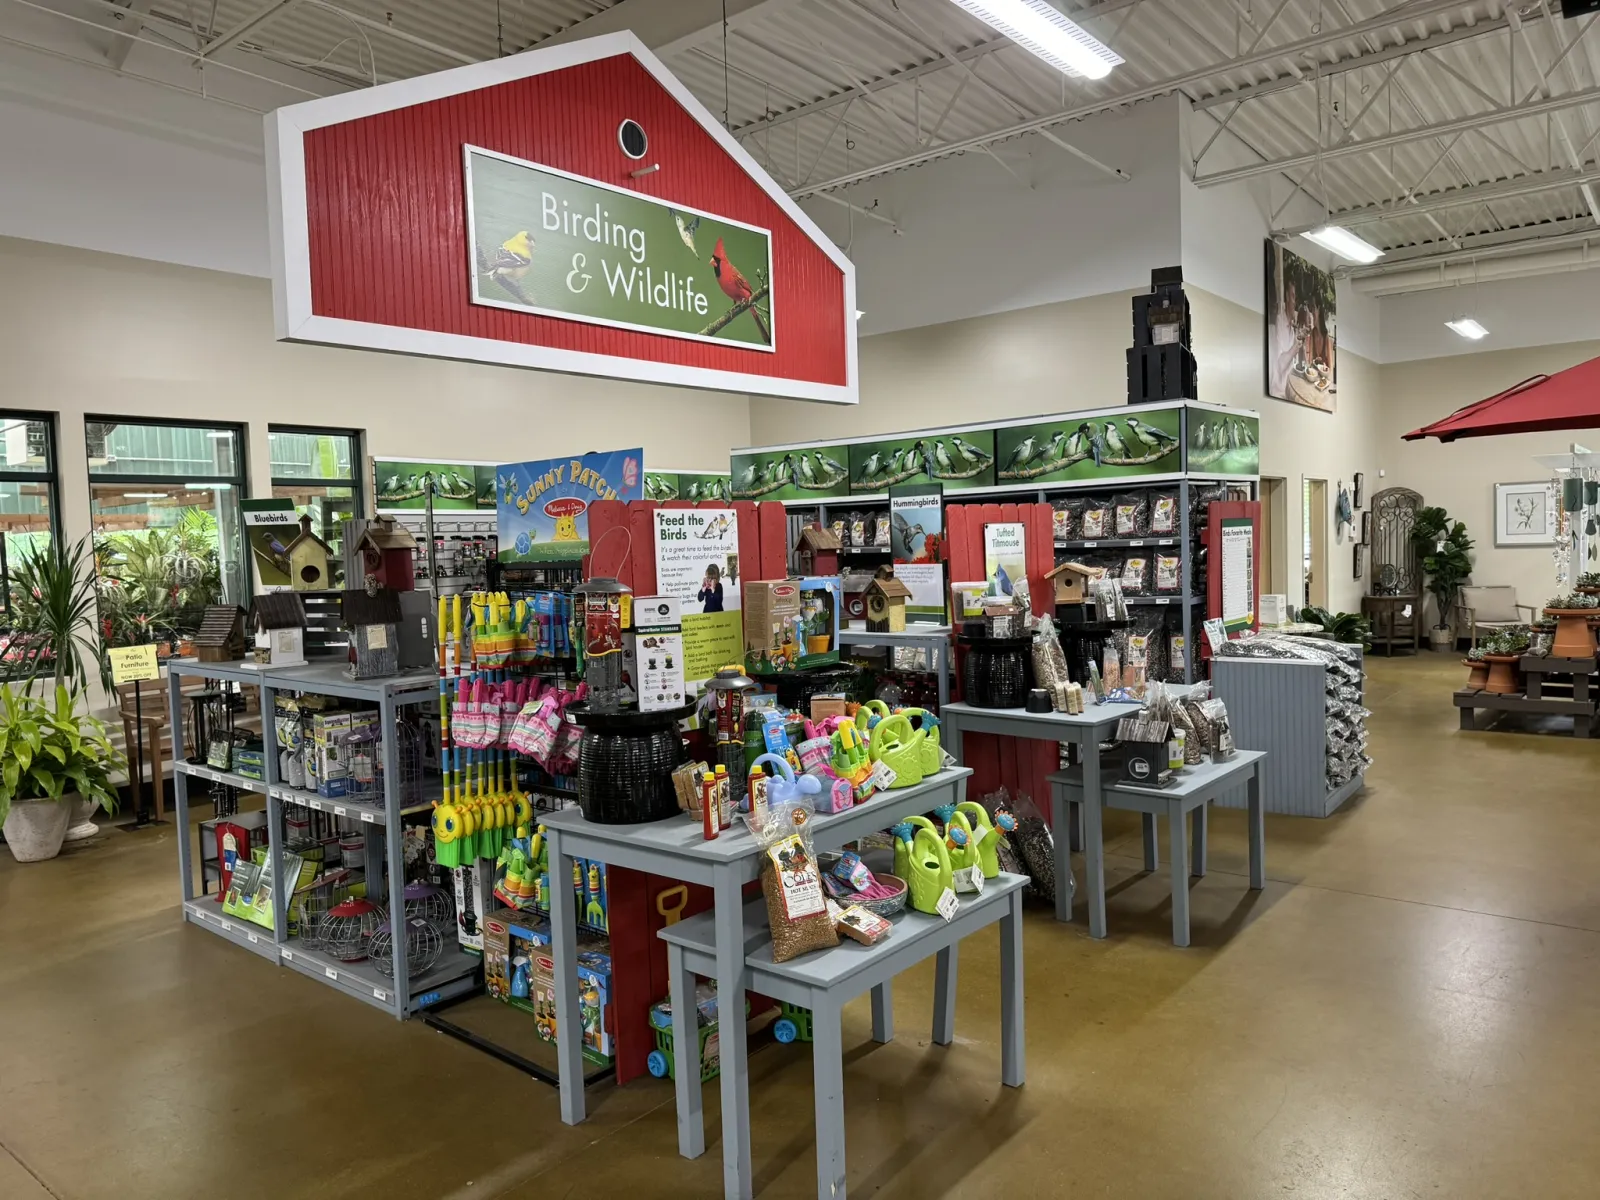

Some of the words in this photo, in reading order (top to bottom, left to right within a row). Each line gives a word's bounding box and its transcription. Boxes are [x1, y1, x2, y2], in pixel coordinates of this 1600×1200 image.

[541, 192, 645, 263] Birding
[566, 252, 592, 293] &
[601, 259, 708, 315] Wildlife
[516, 464, 565, 515] SUNNY
[569, 460, 618, 500] PATCH
[892, 498, 939, 508] Hummingbirds
[254, 513, 288, 522] Bluebirds
[660, 513, 685, 526] Feed
[688, 513, 704, 526] the
[660, 528, 687, 540] Birds
[996, 527, 1015, 538] Tufted
[992, 538, 1020, 548] Titmouse
[120, 661, 149, 669] Furniture
